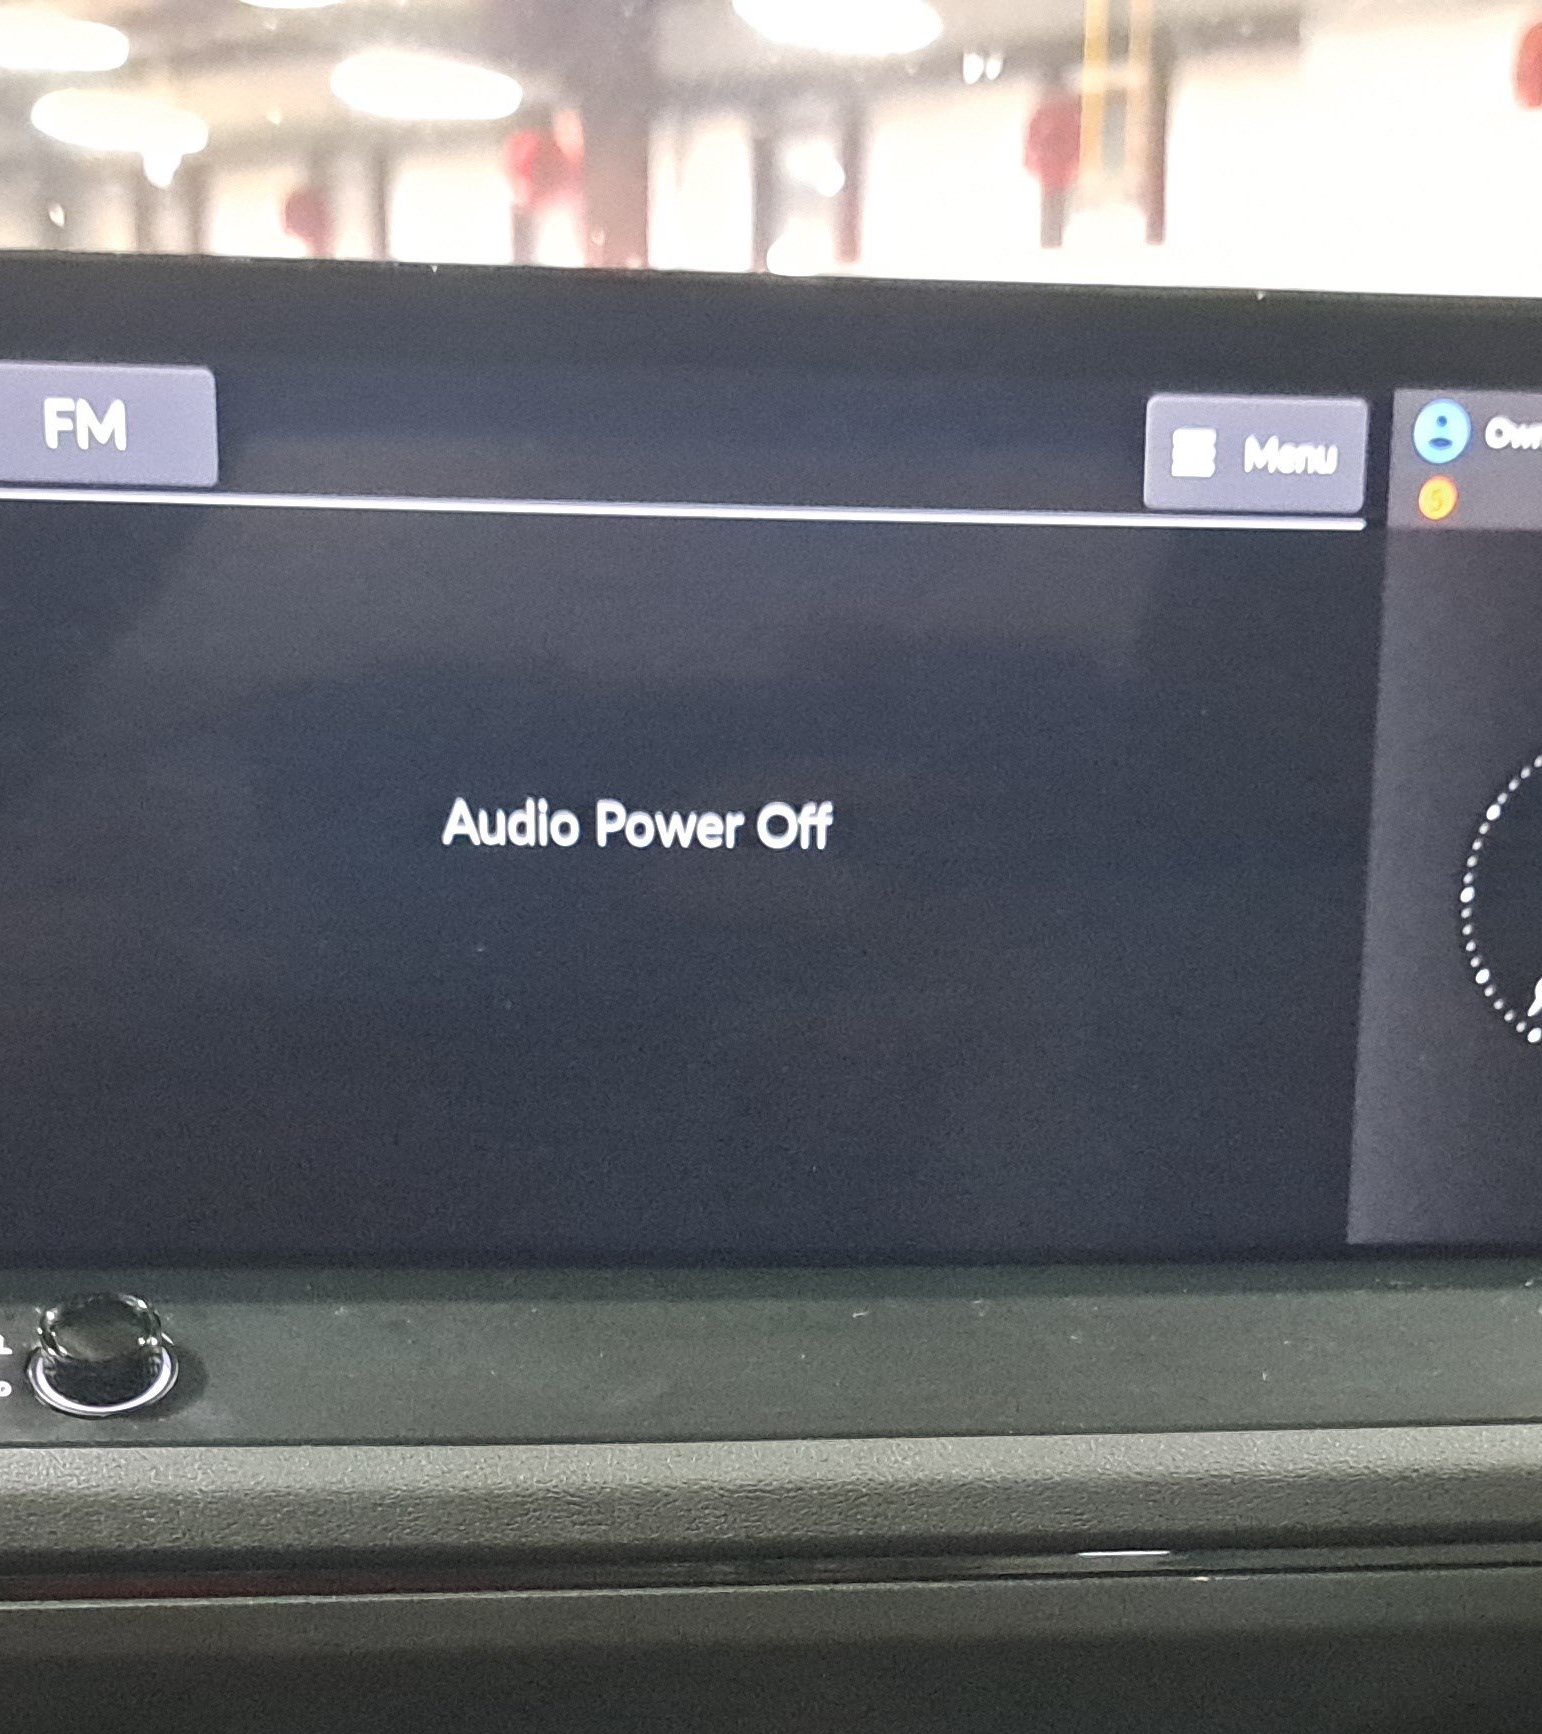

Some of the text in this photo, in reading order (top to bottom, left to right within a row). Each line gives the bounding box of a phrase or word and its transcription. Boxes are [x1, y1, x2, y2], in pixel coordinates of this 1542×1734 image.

[43, 397, 128, 451] FM
[1244, 434, 1339, 475] Menu
[442, 797, 834, 850] Audio Power Off
